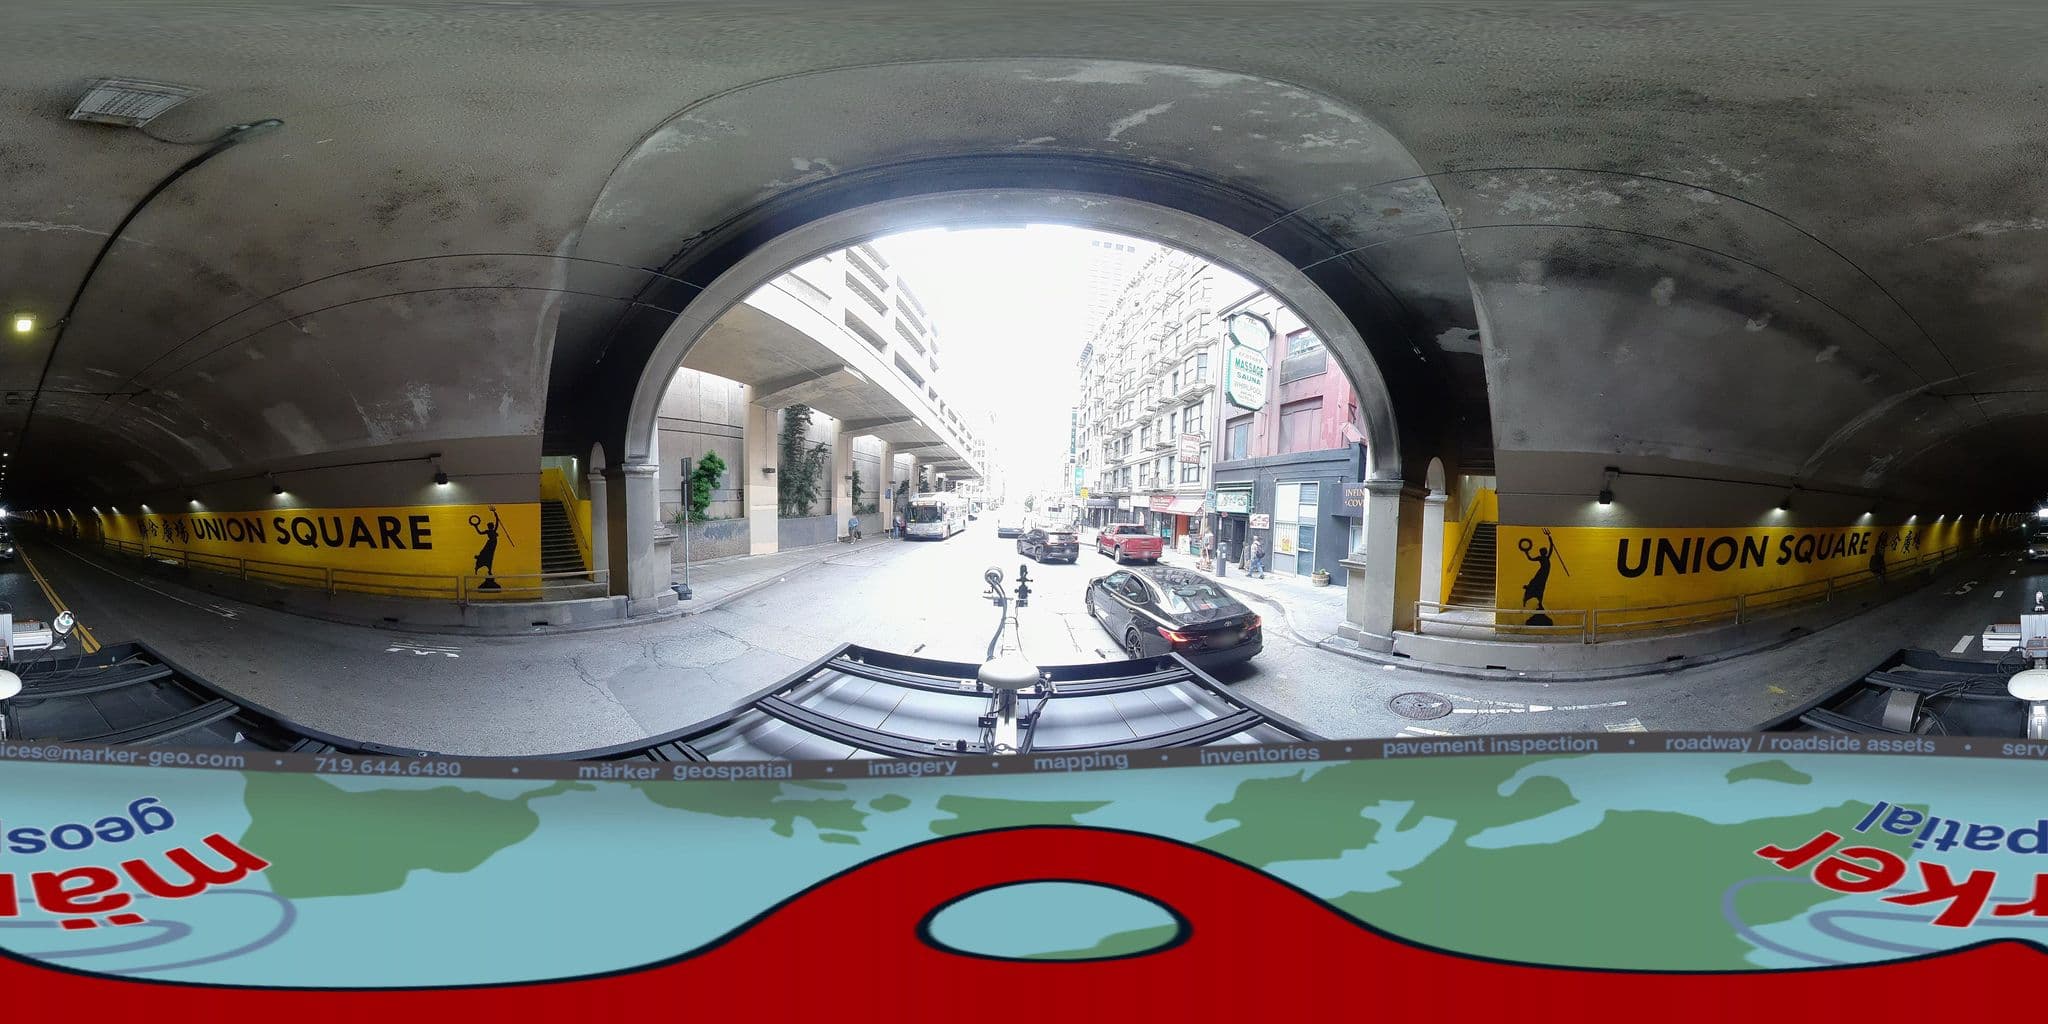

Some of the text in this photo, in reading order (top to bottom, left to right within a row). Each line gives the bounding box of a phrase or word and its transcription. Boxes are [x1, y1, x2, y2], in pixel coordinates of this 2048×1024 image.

[1235, 357, 1265, 378] MASSAGE
[1236, 371, 1262, 386] SAUNA
[191, 514, 432, 550] UNION SQUARE
[1616, 531, 1871, 578] UNION SQUARE
